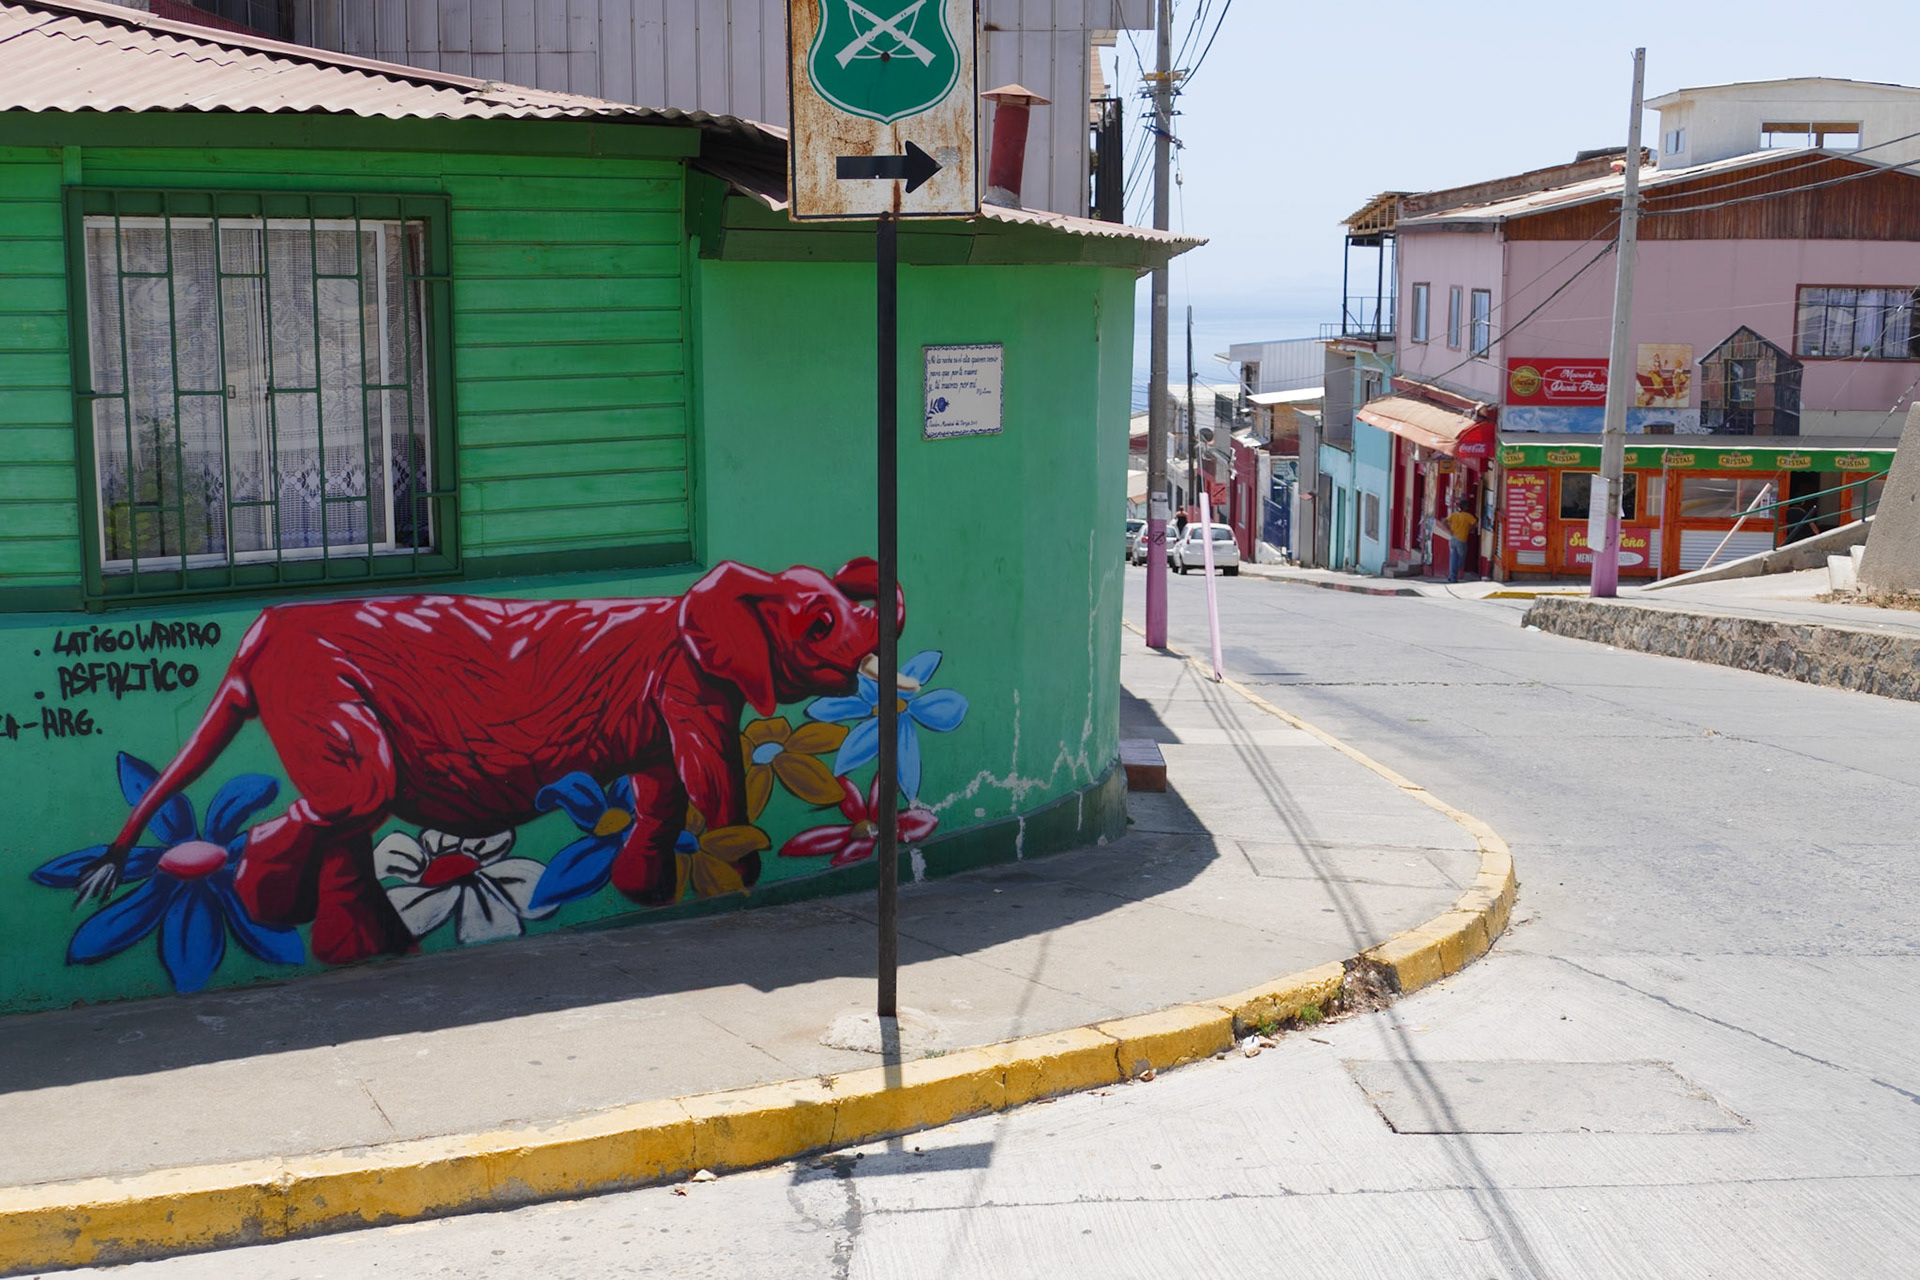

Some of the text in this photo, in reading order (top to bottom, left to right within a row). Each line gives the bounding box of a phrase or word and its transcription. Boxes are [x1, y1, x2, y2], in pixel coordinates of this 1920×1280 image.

[1549, 454, 1577, 462] CRISTAL
[1668, 456, 1692, 464] RISTAL
[1720, 456, 1750, 464] CRISTAL
[1778, 456, 1808, 466] CRISTAL
[1837, 458, 1868, 467] CRISTAL
